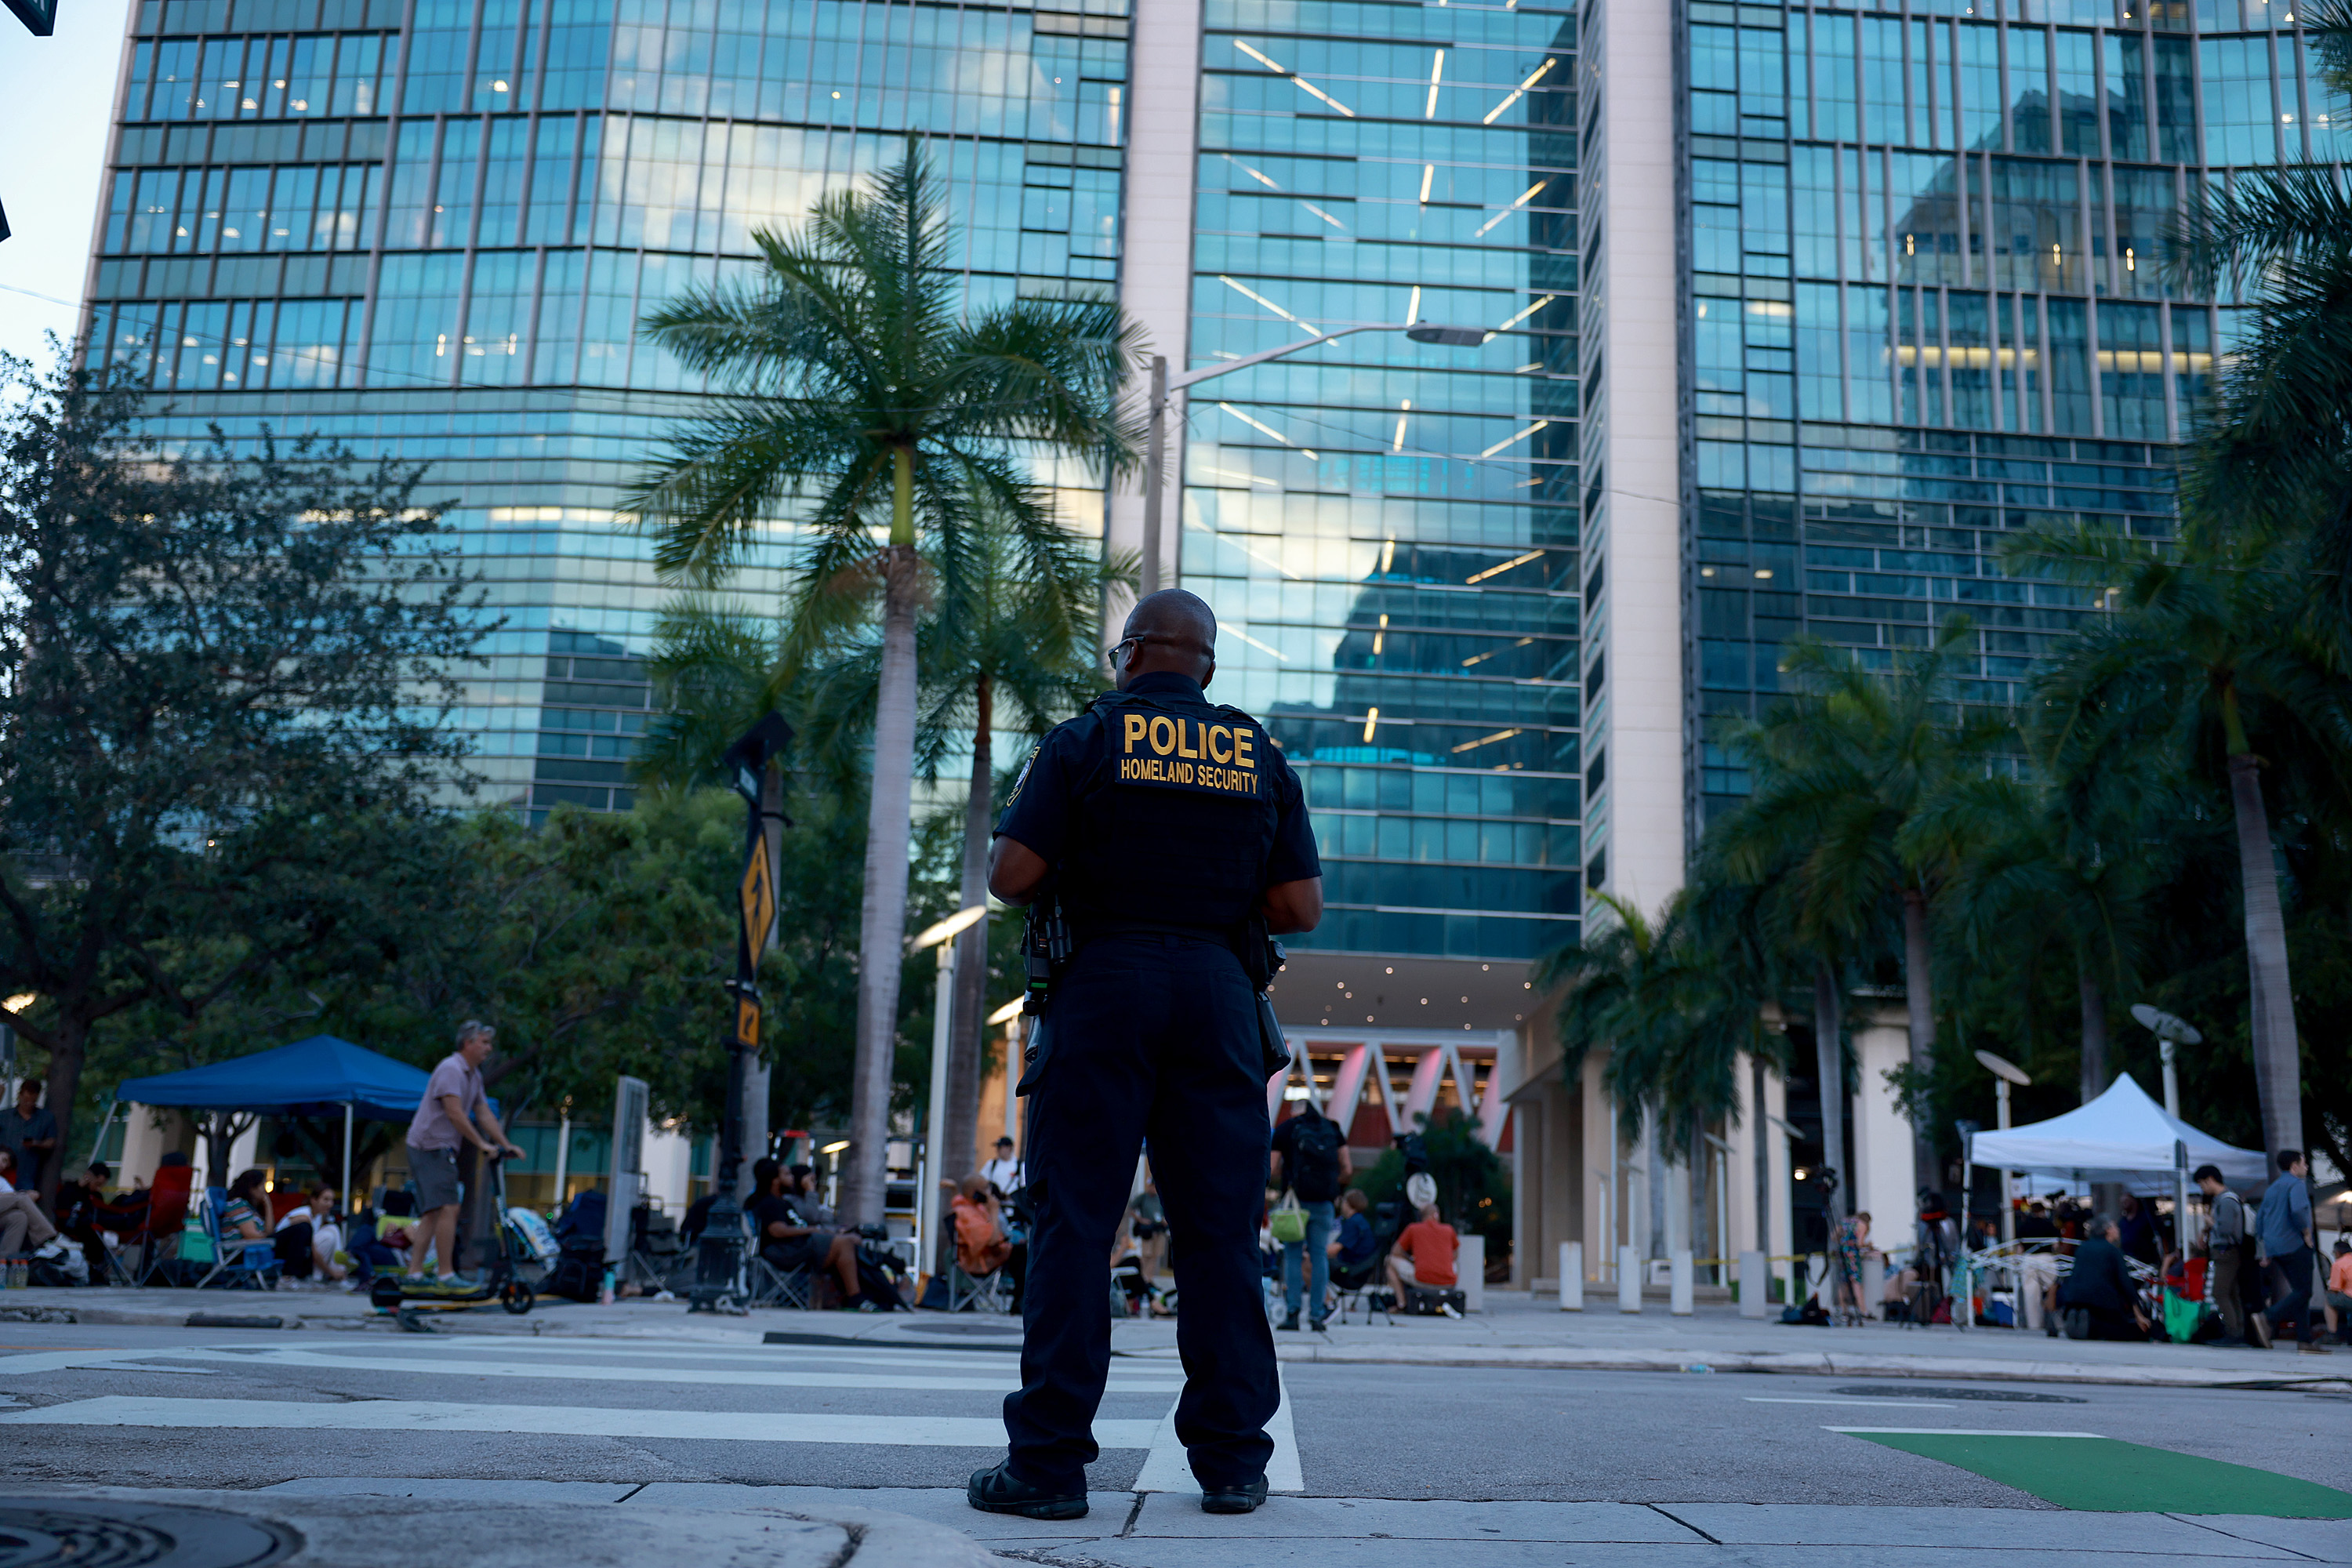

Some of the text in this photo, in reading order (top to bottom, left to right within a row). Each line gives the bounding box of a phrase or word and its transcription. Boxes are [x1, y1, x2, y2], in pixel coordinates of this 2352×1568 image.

[1123, 714, 1255, 768] POLICE
[1120, 758, 1258, 794] HOMELAND SECURITY
